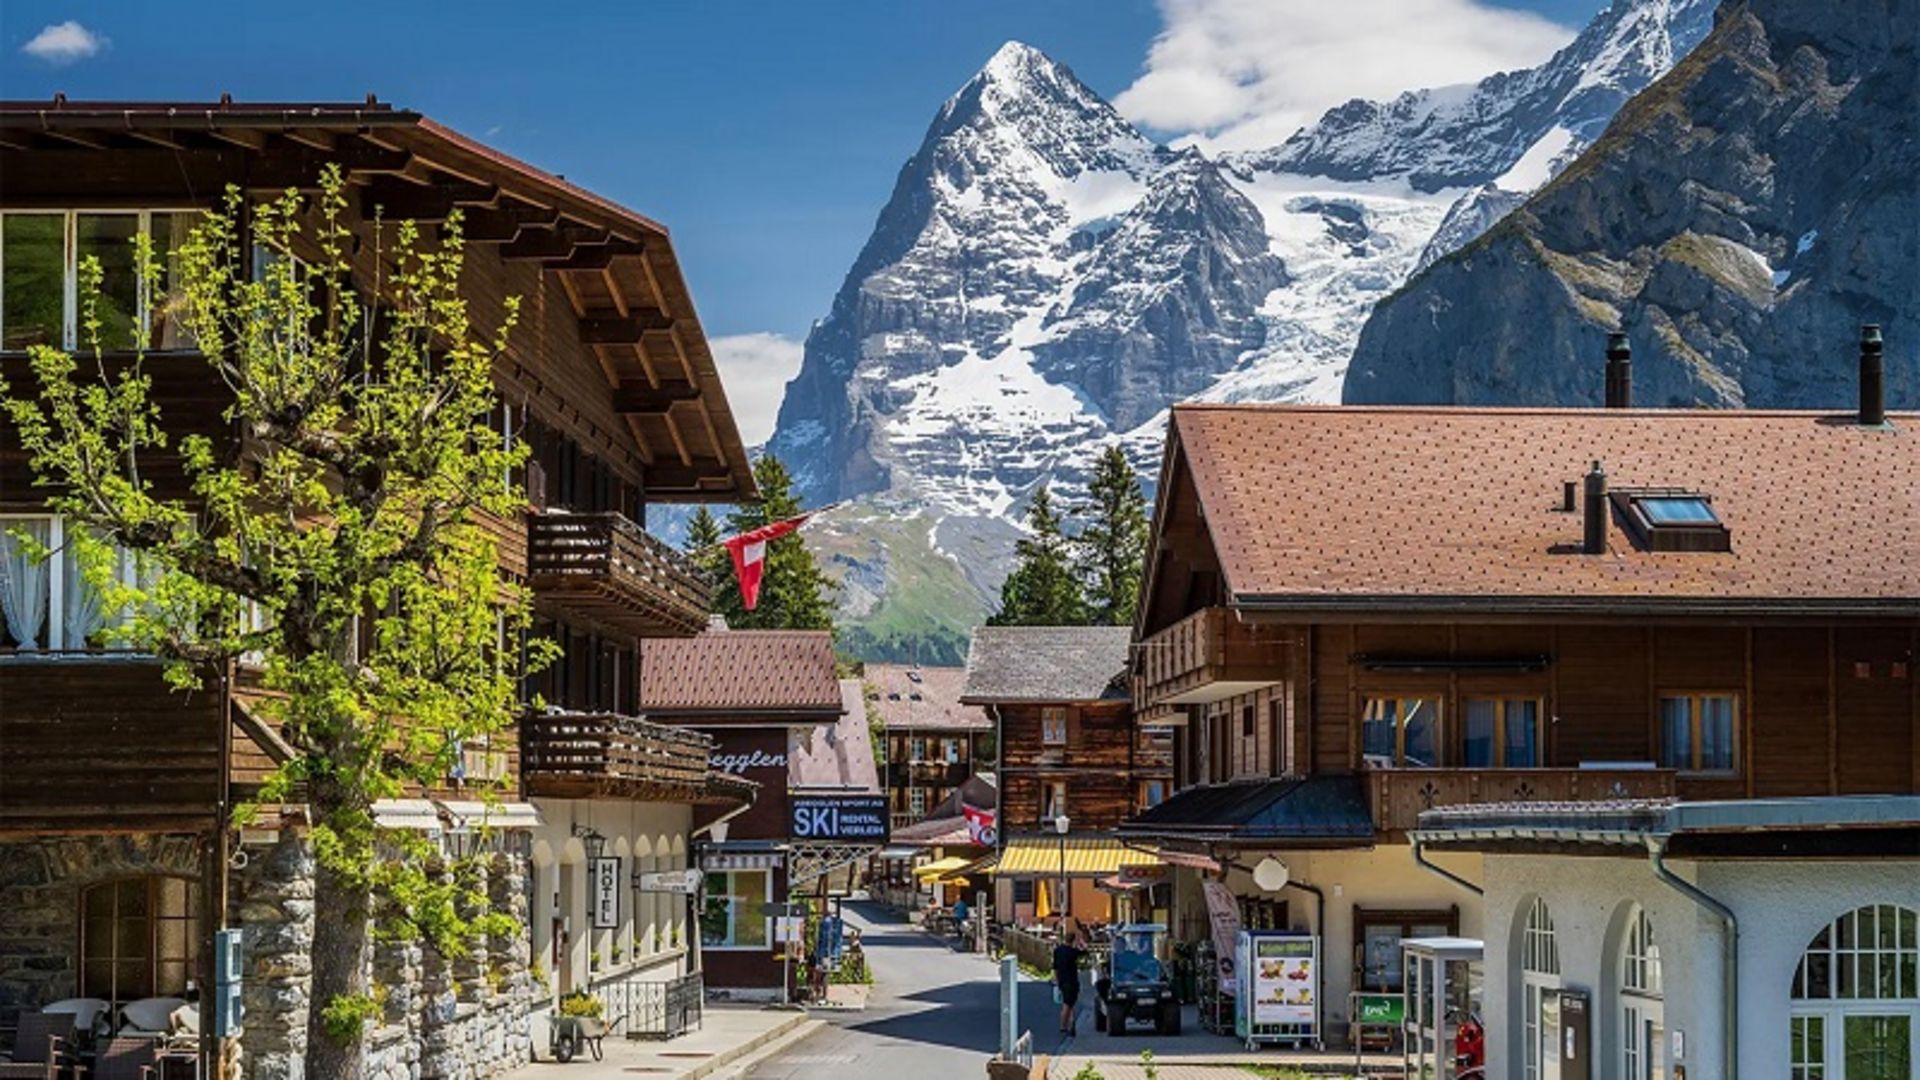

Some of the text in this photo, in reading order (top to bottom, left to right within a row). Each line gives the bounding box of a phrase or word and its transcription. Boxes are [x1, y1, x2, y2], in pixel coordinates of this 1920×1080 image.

[706, 749, 789, 773] egglen
[794, 808, 838, 836] SKI
[840, 814, 881, 824] RENTAL
[840, 825, 884, 835] VERLEIH
[601, 863, 614, 923] HOTEL
